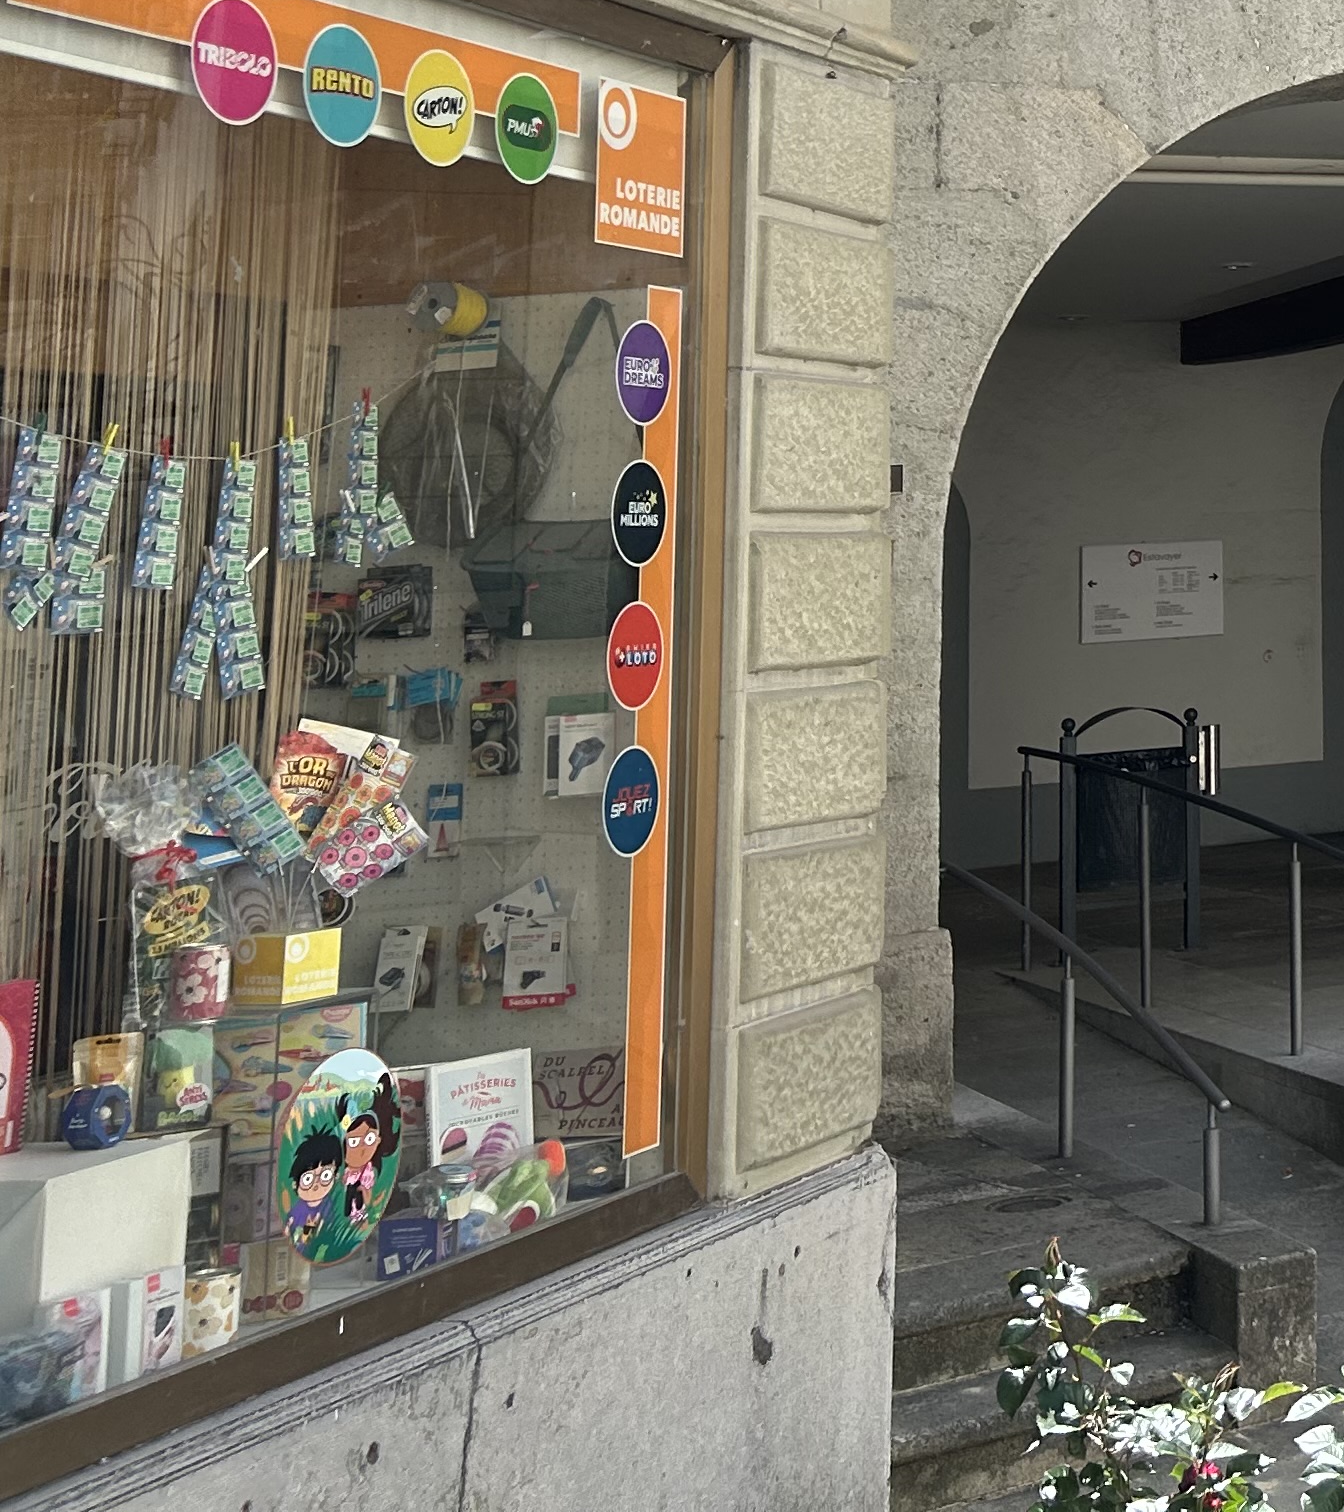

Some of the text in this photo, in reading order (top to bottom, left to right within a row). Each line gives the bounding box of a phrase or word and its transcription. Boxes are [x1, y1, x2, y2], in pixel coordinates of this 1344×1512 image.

[197, 41, 272, 78] TRIBOLO
[310, 66, 375, 100] RENTO
[416, 96, 463, 120] CARTON!
[506, 118, 531, 137] PMU
[615, 177, 681, 211] LOTERIE
[599, 202, 680, 238] ROMANDE
[624, 358, 651, 373] EURO
[623, 371, 664, 388] DREAMS
[628, 501, 651, 514] EURO
[620, 513, 659, 528] MILLIONS
[360, 584, 412, 622] Trilene
[625, 650, 657, 667] LOTO
[612, 784, 651, 803] JOUEZ
[543, 1055, 566, 1068] DU
[538, 1065, 604, 1080] SCALPEL
